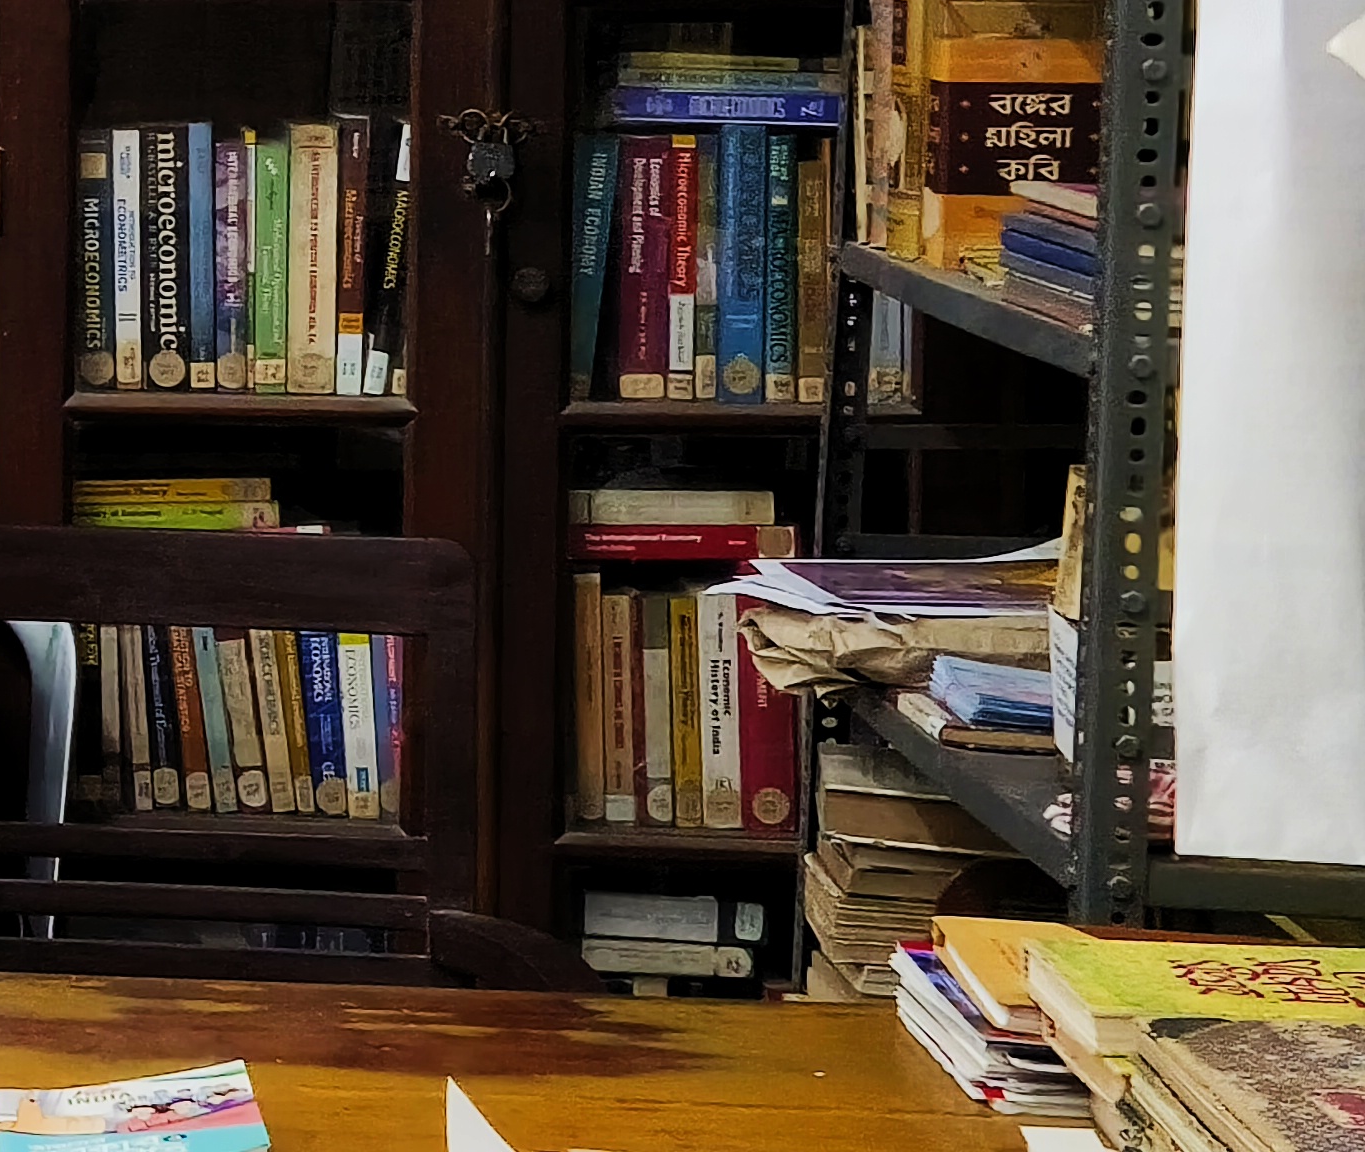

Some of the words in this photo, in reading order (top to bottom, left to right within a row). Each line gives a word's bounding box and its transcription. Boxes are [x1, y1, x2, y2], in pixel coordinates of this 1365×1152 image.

[988, 91, 1073, 116] বঙ্গের
[983, 121, 1073, 149] মহিলা
[587, 151, 608, 201] INDIAN
[632, 157, 647, 215] Development
[648, 157, 663, 206] Economics
[996, 154, 1061, 182] কবি
[677, 151, 693, 244] Microeconomic
[115, 198, 128, 294] ECONOMETRICS
[383, 189, 410, 291] MACROECONOMICS
[579, 207, 603, 276] ECONOMY
[674, 244, 693, 288] Theory
[83, 197, 101, 350] MICROECONOMICS
[311, 637, 324, 704] ECONOMICS
[345, 648, 361, 730] ECONOMICS
[707, 658, 722, 706] History
[722, 658, 732, 717] Economic
[710, 708, 722, 722] of
[711, 724, 722, 755] India
